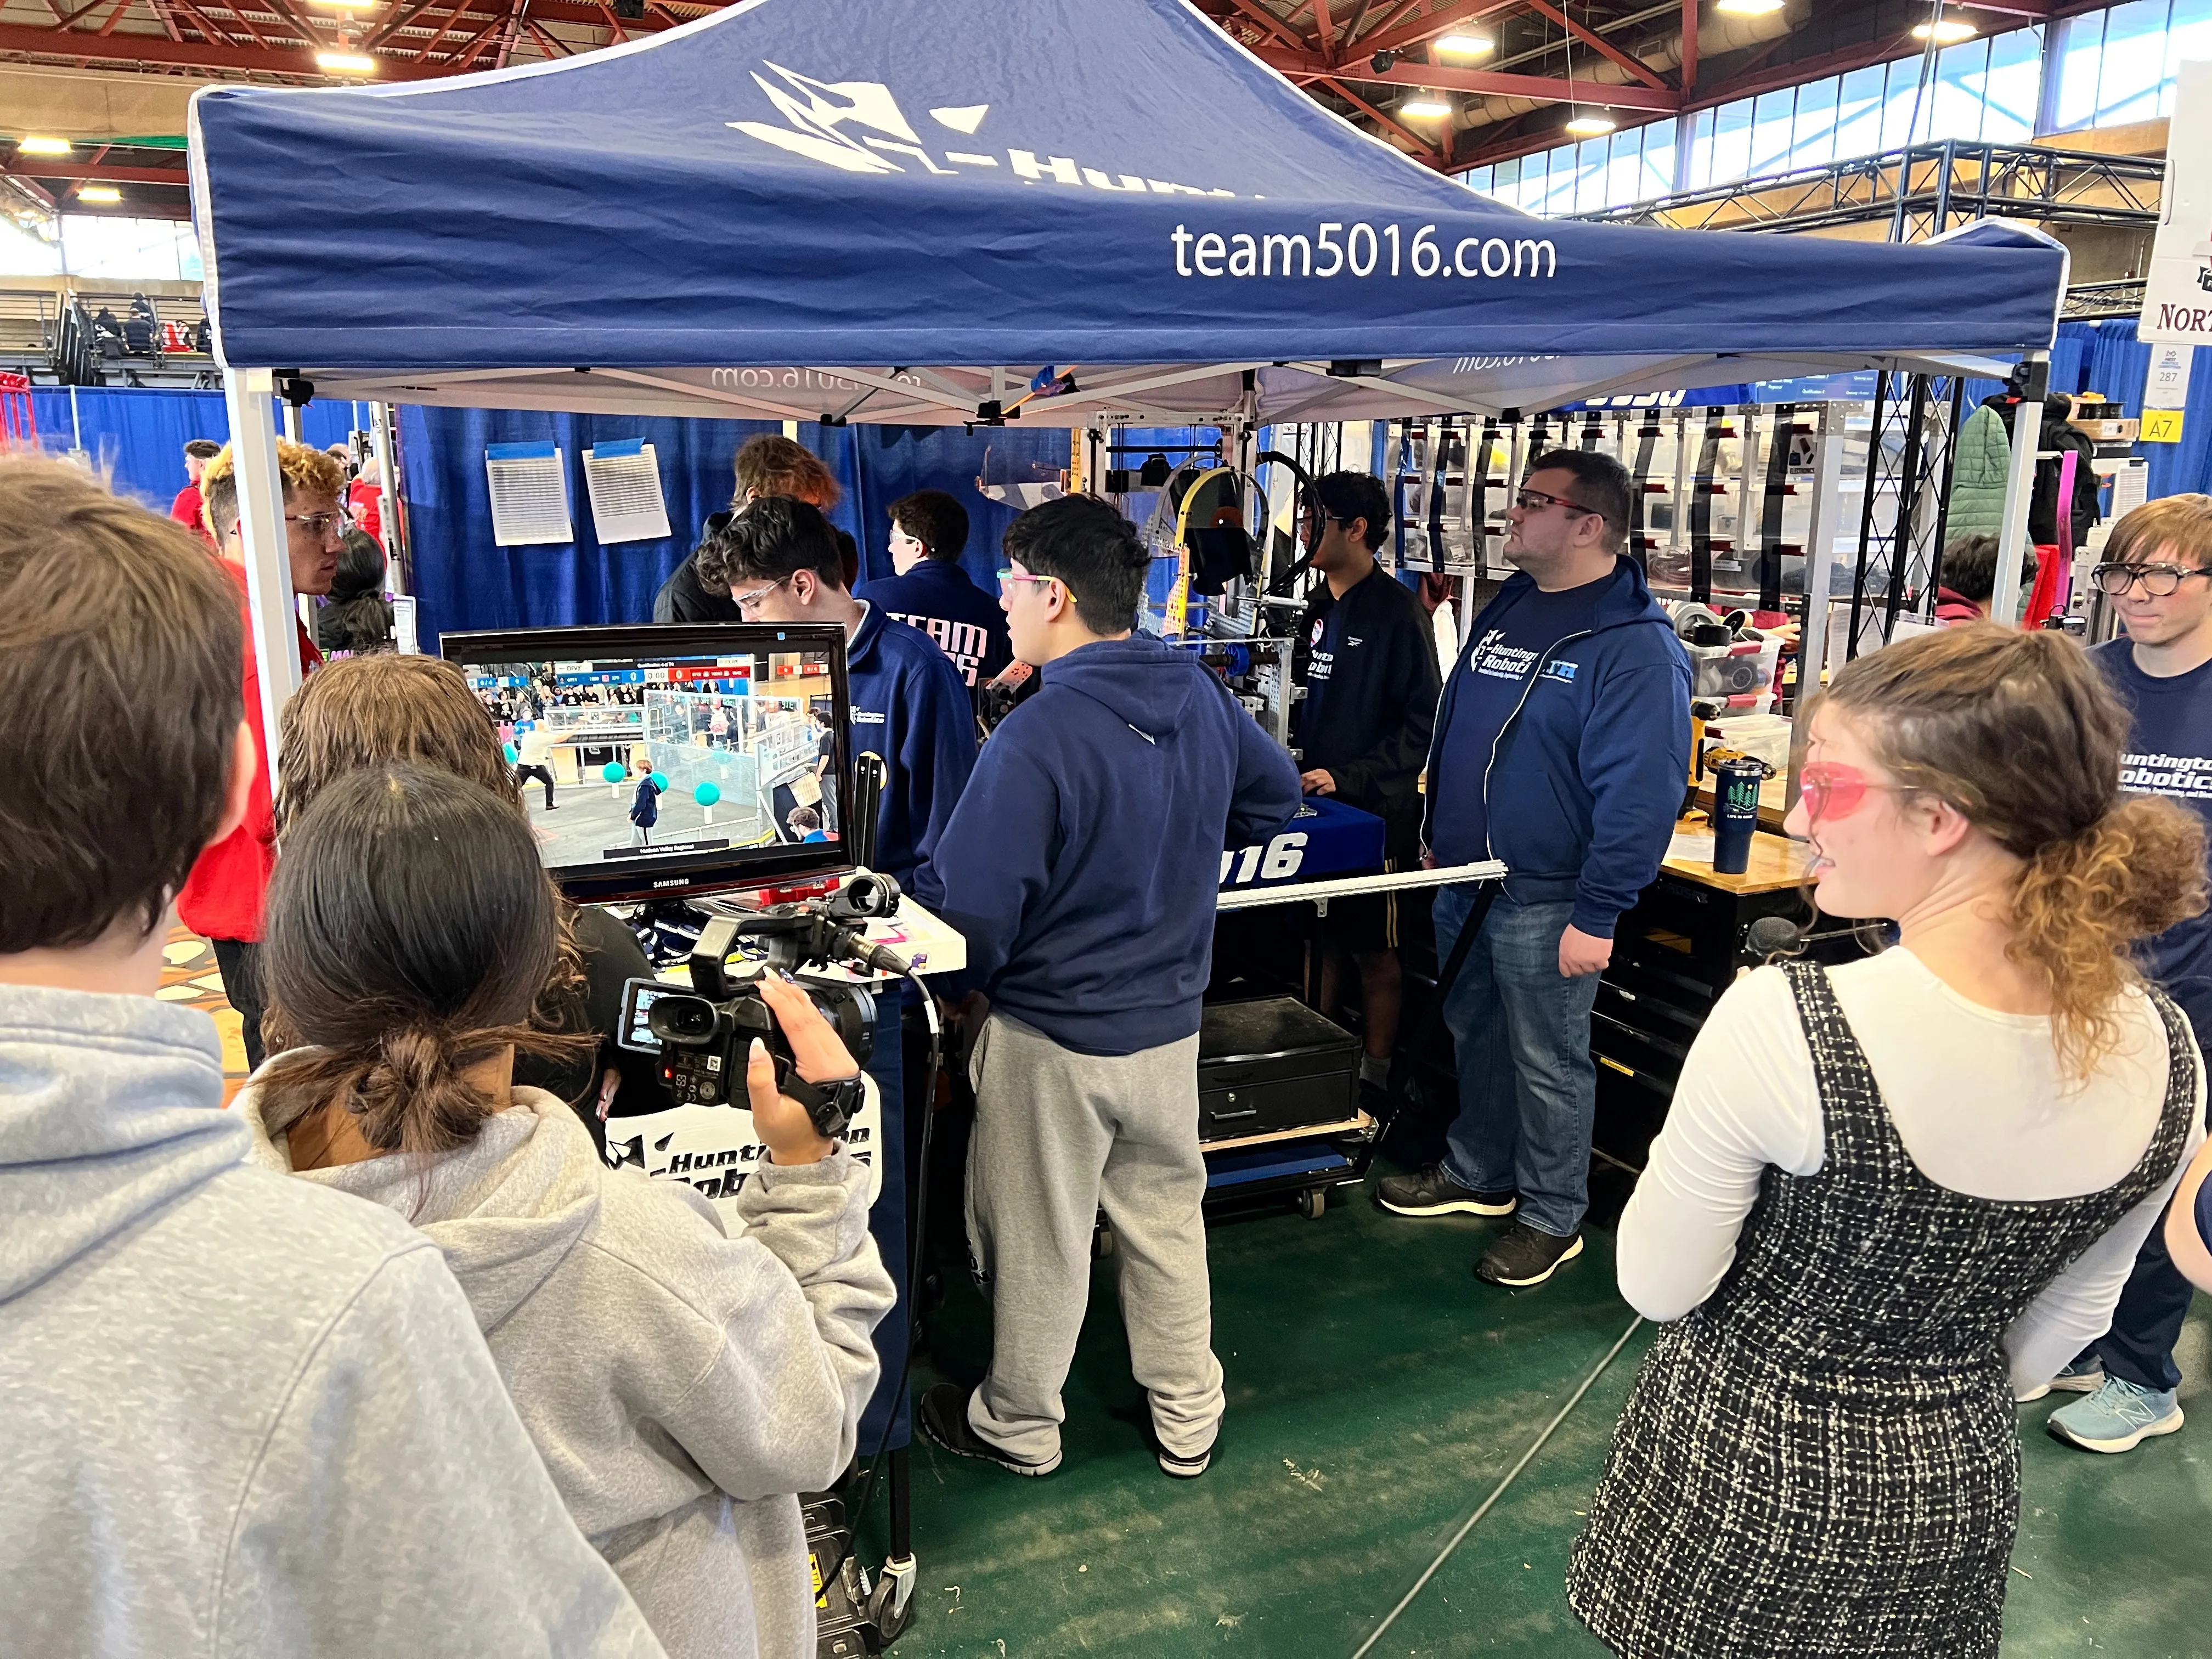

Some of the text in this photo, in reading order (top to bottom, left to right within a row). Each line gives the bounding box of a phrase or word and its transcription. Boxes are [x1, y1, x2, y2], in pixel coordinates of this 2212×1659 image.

[1171, 222, 1557, 278] team5016.com
[2159, 372, 2177, 382] 287
[2148, 420, 2173, 438] A7
[630, 672, 637, 681] 0
[676, 670, 682, 679] 0
[2120, 753, 2212, 772] untingto
[2118, 767, 2212, 791] obotic
[674, 843, 695, 851] Regional
[653, 878, 690, 888] SAMSUNG
[668, 1127, 870, 1175] Huntin
